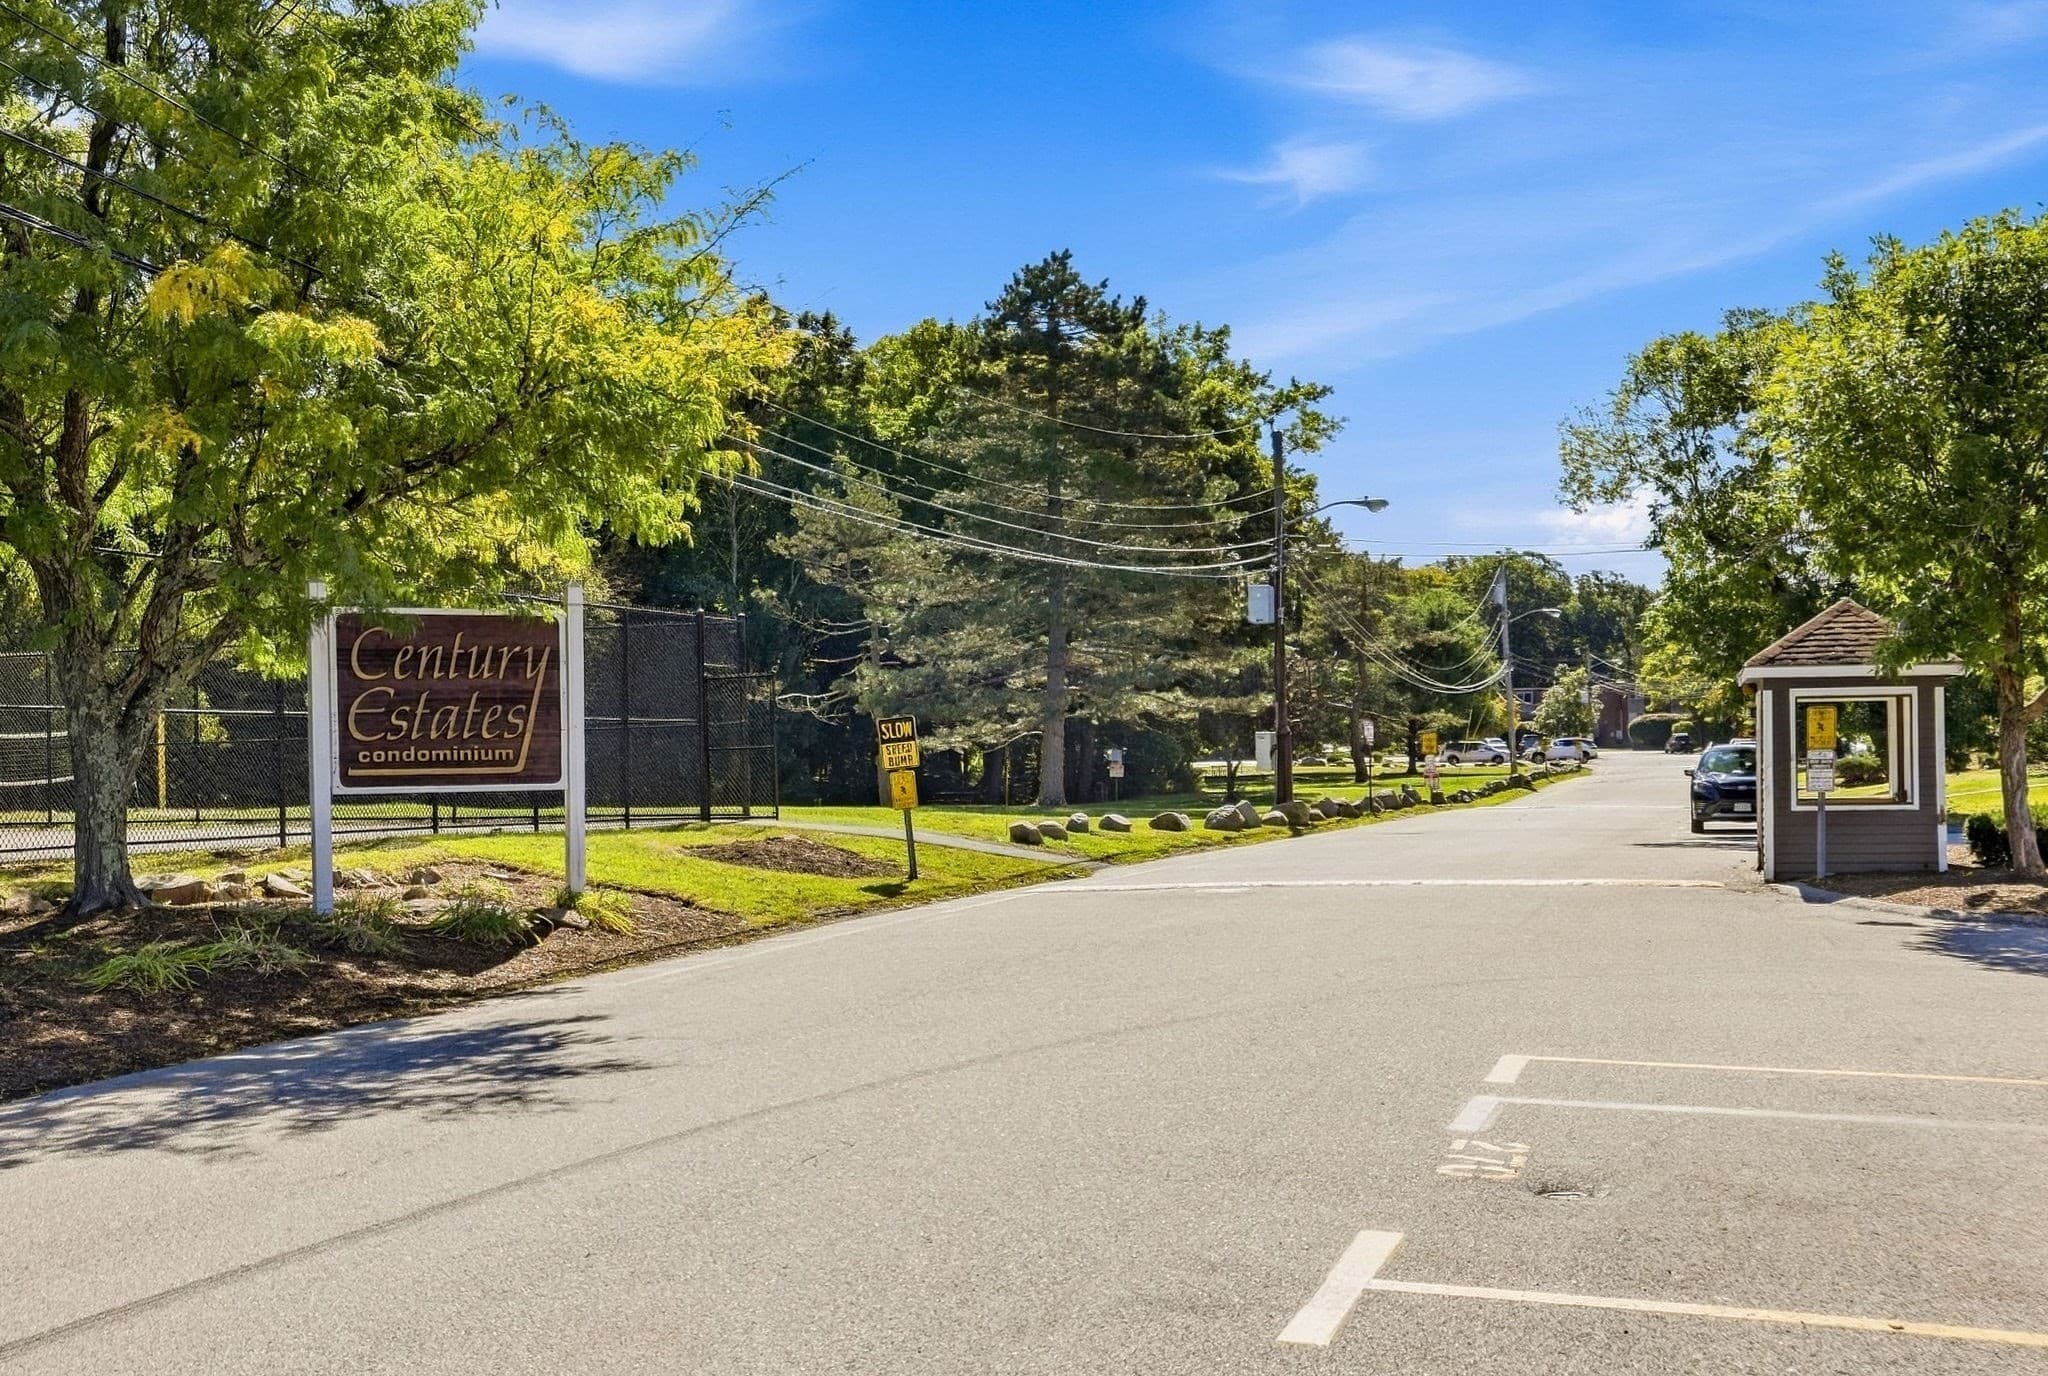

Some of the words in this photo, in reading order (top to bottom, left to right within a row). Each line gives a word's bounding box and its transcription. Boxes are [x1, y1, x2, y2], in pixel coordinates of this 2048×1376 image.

[350, 627, 551, 681] Century
[348, 686, 526, 741] Estates
[881, 721, 912, 740] SLOW
[358, 746, 514, 763] condominium
[886, 743, 912, 755] SPEED
[889, 755, 914, 767] BUMP
